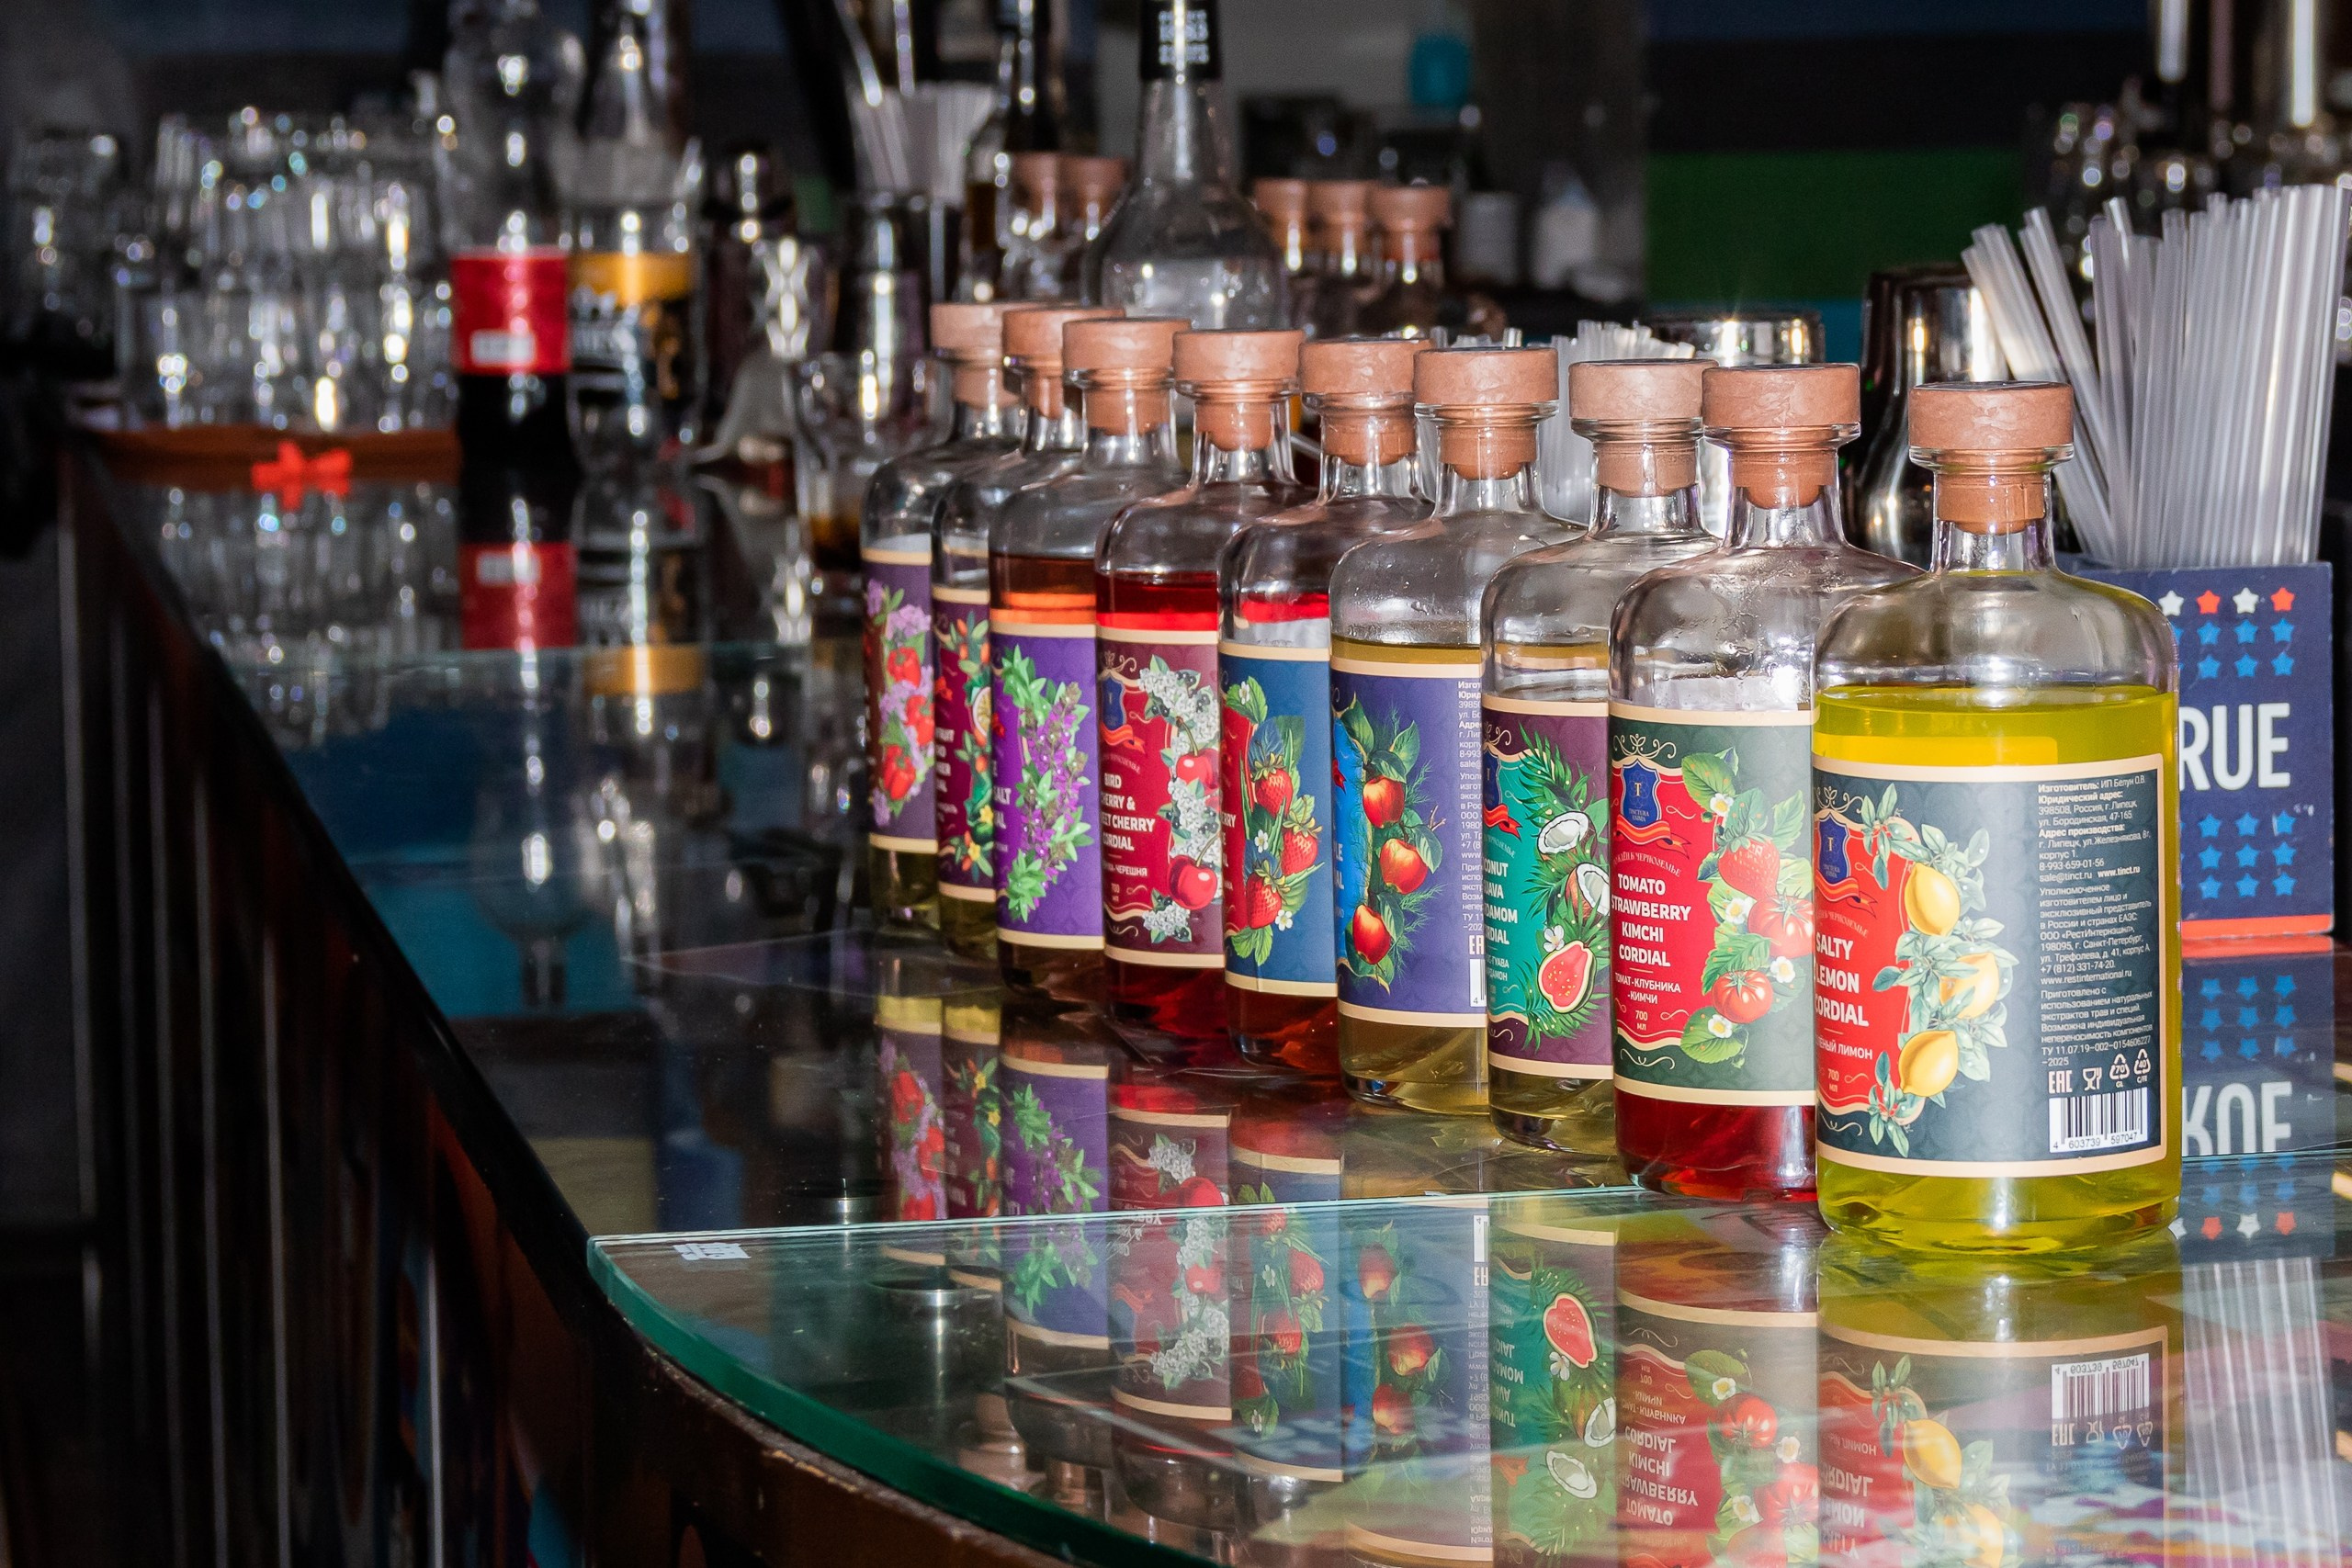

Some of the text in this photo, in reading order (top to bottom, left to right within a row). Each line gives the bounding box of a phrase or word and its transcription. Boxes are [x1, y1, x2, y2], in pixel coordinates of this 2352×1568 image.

[2178, 702, 2290, 792] RUE
[1104, 773, 1122, 789] BIRD
[2038, 782, 2099, 794] Изготовитель:
[2100, 779, 2112, 788] ИП
[1634, 782, 1642, 796] T
[1126, 795, 1136, 811] &
[2038, 791, 2123, 805] Юридический адрес:
[2074, 804, 2104, 815] Россия,
[1112, 814, 1156, 833] CHERRY
[2038, 819, 2051, 829] ул.
[2038, 824, 2125, 839] Адрес производства:
[2039, 840, 2045, 849] г.
[2048, 839, 2081, 849] Липецк,
[2039, 850, 2078, 861] корпус 1.
[2039, 858, 2105, 872] 8-993-659-01-56
[2039, 865, 2141, 884] sale@tinct.ru www.tinct.ru
[1617, 873, 1666, 896] TOMATO
[2040, 884, 2110, 897] Уполномоченное
[1611, 895, 1691, 921] STRAWBERRY
[2040, 897, 2102, 908] изготовителем
[2104, 895, 2121, 903] лицо
[2040, 900, 2152, 919] эксклюзивный представитель
[2047, 920, 2078, 929] России
[2086, 917, 2118, 928] странах
[1622, 921, 1664, 942] KIMCHI
[2040, 931, 2060, 941] ООО
[1815, 931, 1853, 961] SALTY
[2041, 942, 2074, 952] 198095,
[2083, 934, 2144, 949] Санкт-Петербург,
[1619, 943, 1671, 967] CORDIAL
[2041, 956, 2052, 965] ул.
[2054, 951, 2101, 964] Трефолева,
[2122, 945, 2144, 955] корпус
[2040, 964, 2052, 974] +7
[2052, 963, 2075, 976] (812)
[1815, 963, 1860, 994] LEMON
[2040, 969, 2132, 986] www.restinternational.ru
[2041, 987, 2100, 1000] Приготовлено
[2041, 991, 2153, 1010] использованием натуральных
[1634, 1010, 1648, 1021] 700
[2041, 1010, 2089, 1021] экстрактов
[2091, 1009, 2109, 1019] трав
[2041, 1014, 2145, 1032] Возможна индивидуальная
[2041, 1032, 2112, 1043] непереносимость
[1838, 1043, 1873, 1060] ЛИМОН
[2041, 1047, 2053, 1056] ТУ
[1827, 1068, 1839, 1082] 700
[2115, 1065, 2126, 1074] 70
[2052, 1132, 2138, 1149] 4 603739 597047
